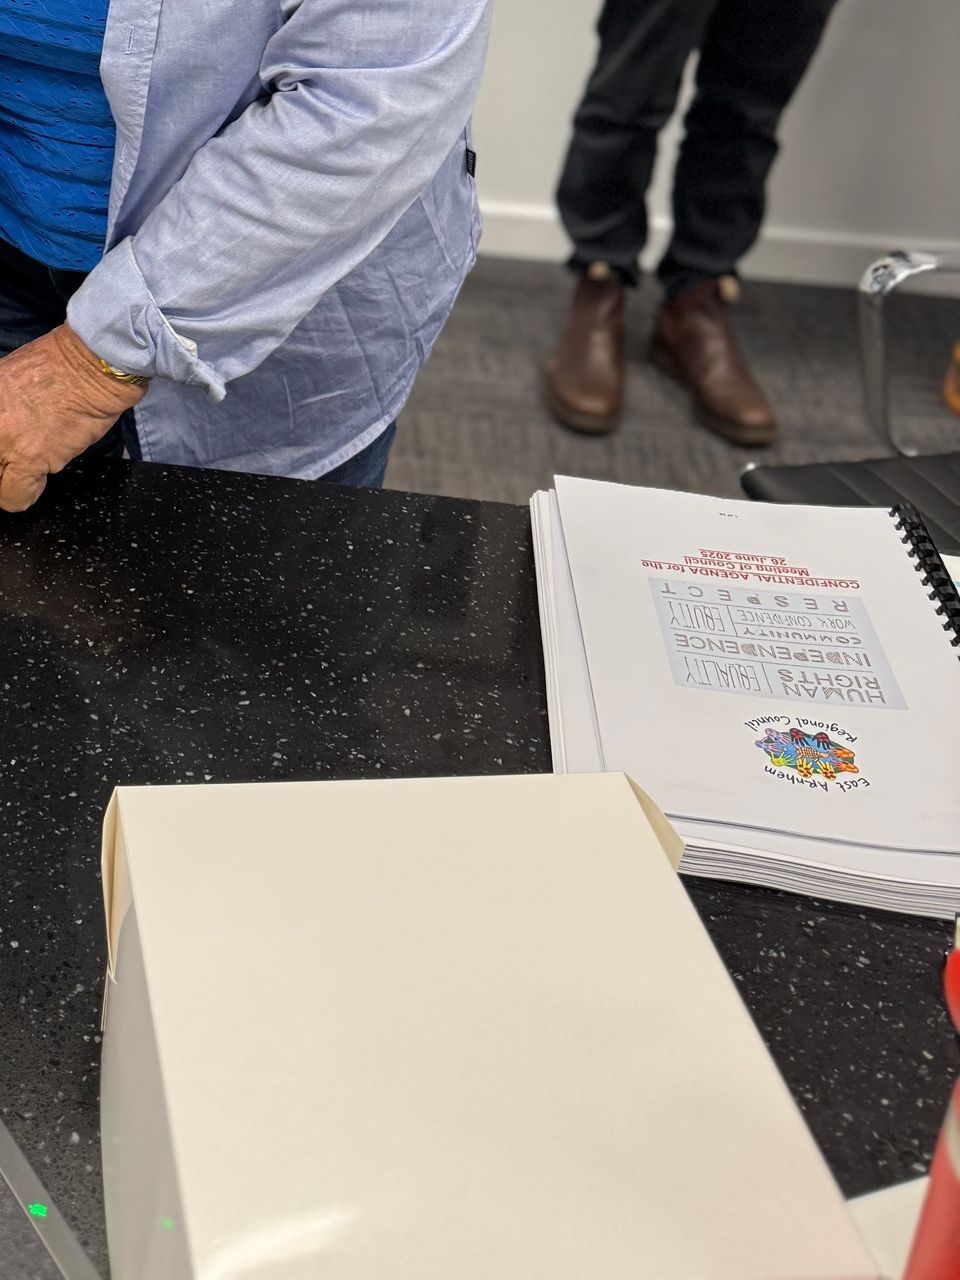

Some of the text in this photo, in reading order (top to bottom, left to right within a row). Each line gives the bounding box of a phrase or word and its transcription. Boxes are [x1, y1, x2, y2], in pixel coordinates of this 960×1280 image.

[683, 556, 735, 570] Council
[699, 549, 786, 566] 26 June 2025
[640, 560, 860, 589] CONFIDENTIAL AGENDA for the
[755, 564, 809, 576] Meeting
[660, 581, 848, 612] RESPECT
[668, 600, 726, 632] EQUITY
[738, 608, 856, 630] WORK CONFIDENCE
[743, 627, 862, 646] COMMUNITY
[676, 633, 871, 668] INDEPENDENCE
[685, 656, 761, 693] EQUALITY
[778, 668, 880, 691] RIGHTS
[782, 683, 887, 705] HUMAN
[743, 714, 858, 744] Regional Council
[840, 777, 871, 793] East
